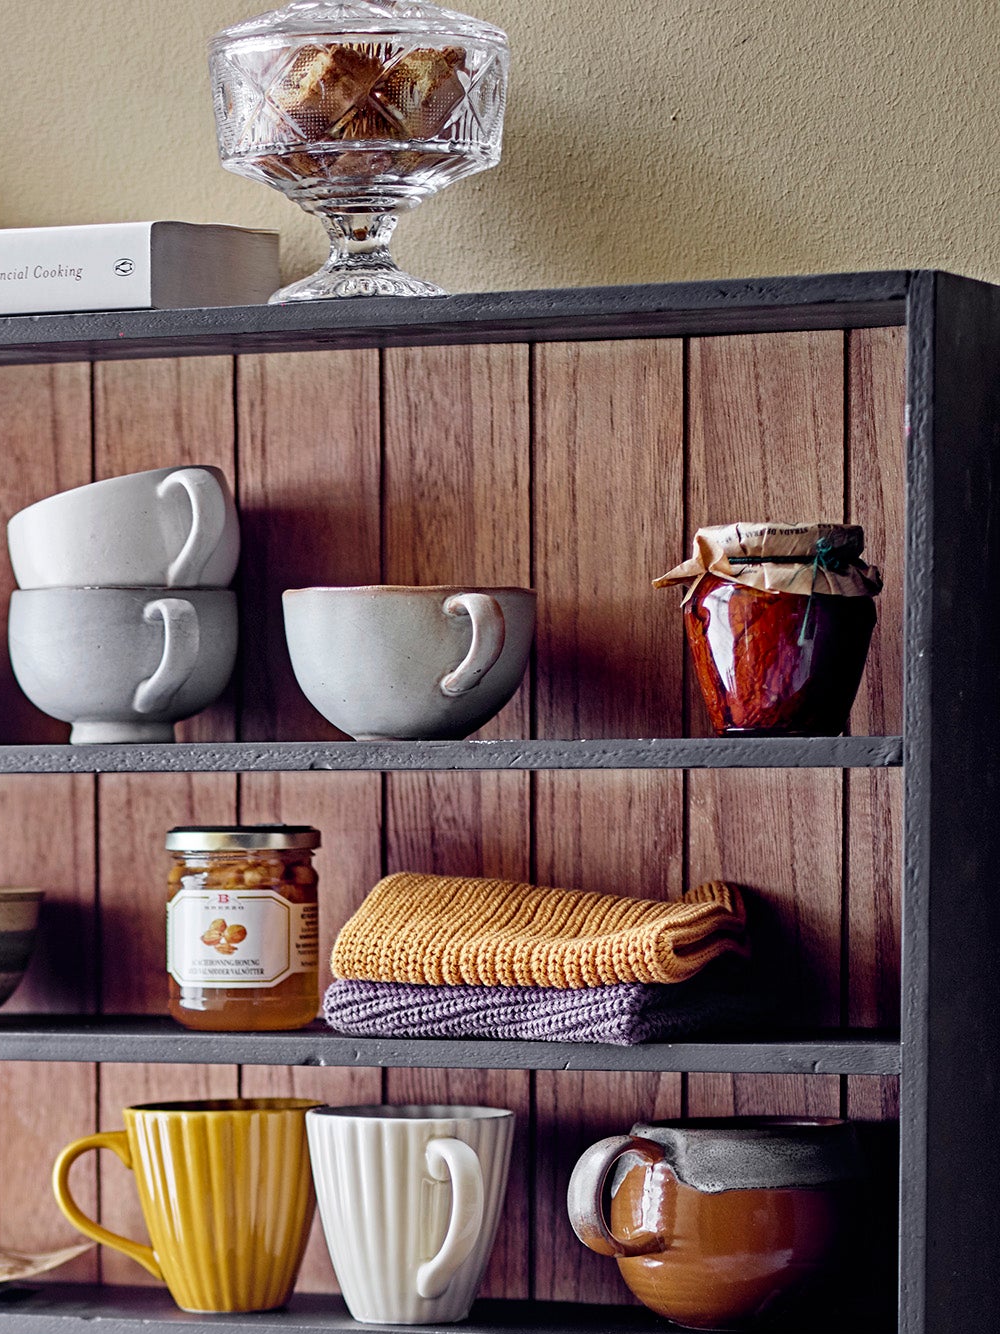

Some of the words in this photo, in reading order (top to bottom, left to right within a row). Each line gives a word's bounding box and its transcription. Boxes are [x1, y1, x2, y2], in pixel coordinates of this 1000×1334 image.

[33, 264, 83, 282] Cooking
[779, 527, 809, 535] STRADA
[218, 894, 229, 903] B
